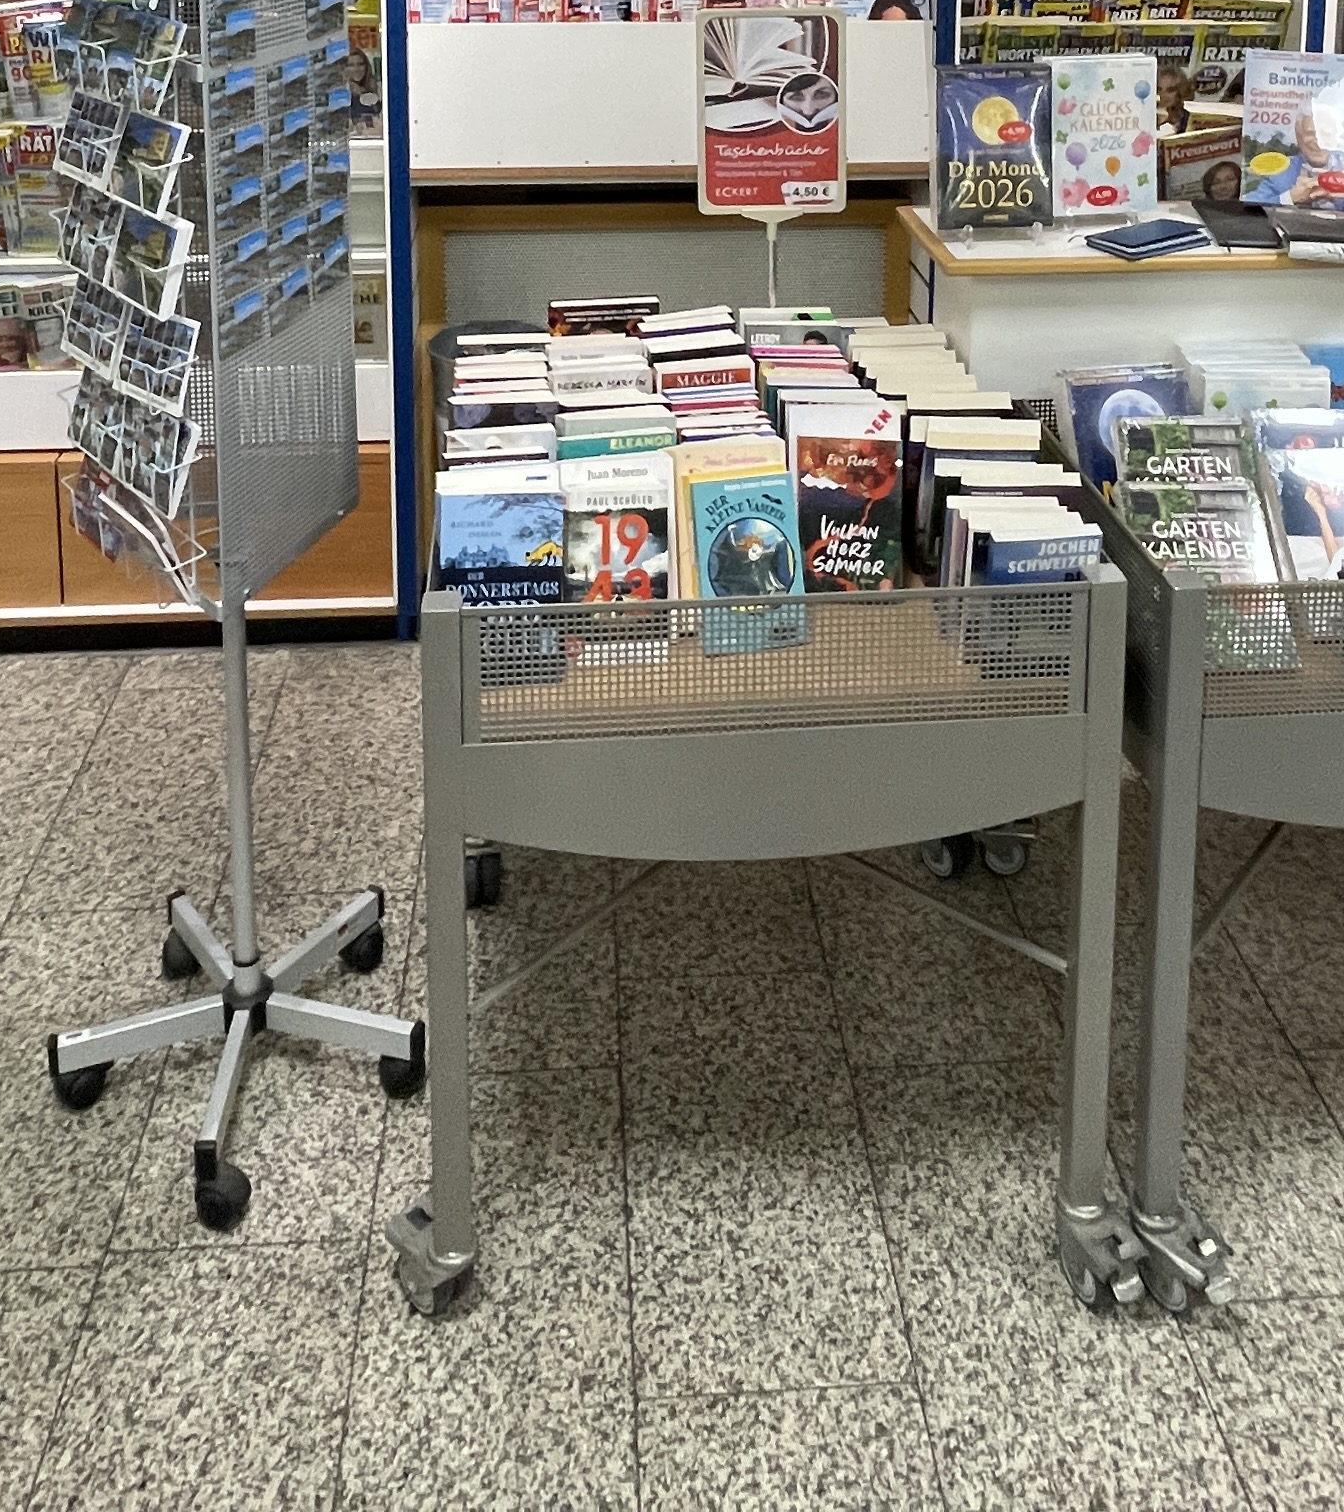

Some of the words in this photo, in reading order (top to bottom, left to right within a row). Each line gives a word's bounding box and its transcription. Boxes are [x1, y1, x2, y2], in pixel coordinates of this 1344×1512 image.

[1070, 116, 1140, 132] KALENDER
[1249, 111, 1292, 126] 2026
[793, 186, 818, 198] 4,50
[958, 178, 1034, 209] 2026
[676, 372, 737, 387] MAGGIE
[610, 435, 673, 450] ELEANOR
[613, 466, 648, 479] Moreno
[1146, 455, 1232, 475] GARTEN
[1152, 520, 1241, 540] GARTEN
[1037, 538, 1100, 557] JOCHEN
[445, 581, 559, 598] DONNERSTAGS
